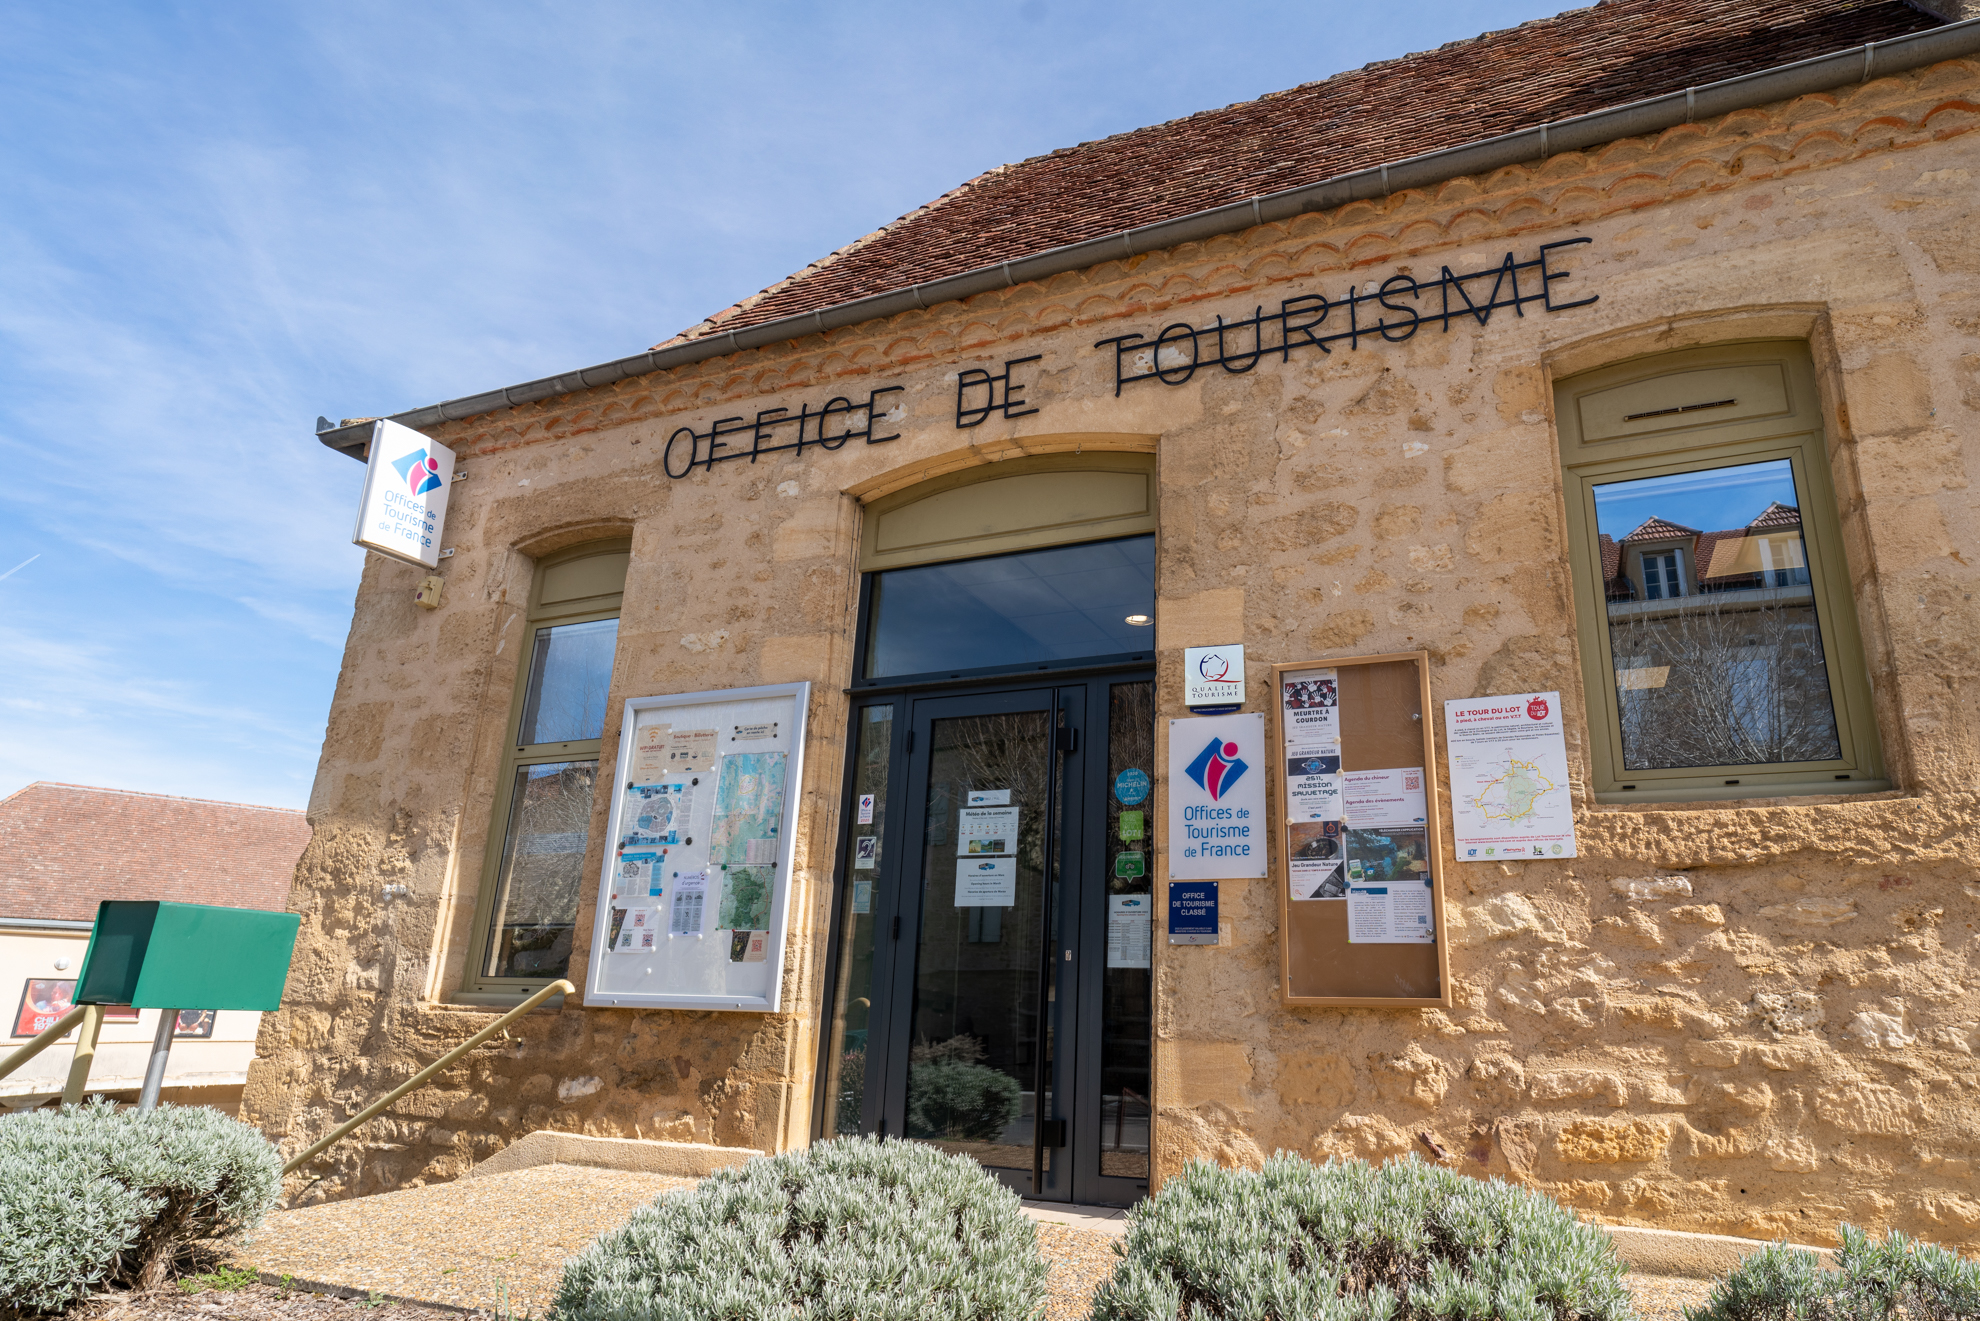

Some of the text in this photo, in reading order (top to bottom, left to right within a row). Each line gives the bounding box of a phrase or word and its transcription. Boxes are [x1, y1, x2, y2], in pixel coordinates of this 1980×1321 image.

[664, 237, 1600, 479] OFFICE DE TOURISME
[384, 490, 436, 520] Offices de
[383, 503, 434, 534] Tourisme
[378, 521, 432, 548] de France
[1192, 684, 1238, 693] QUALITÉ
[1184, 805, 1250, 820] Offices de
[1184, 823, 1250, 839] Tourisme
[1184, 842, 1250, 857] de France
